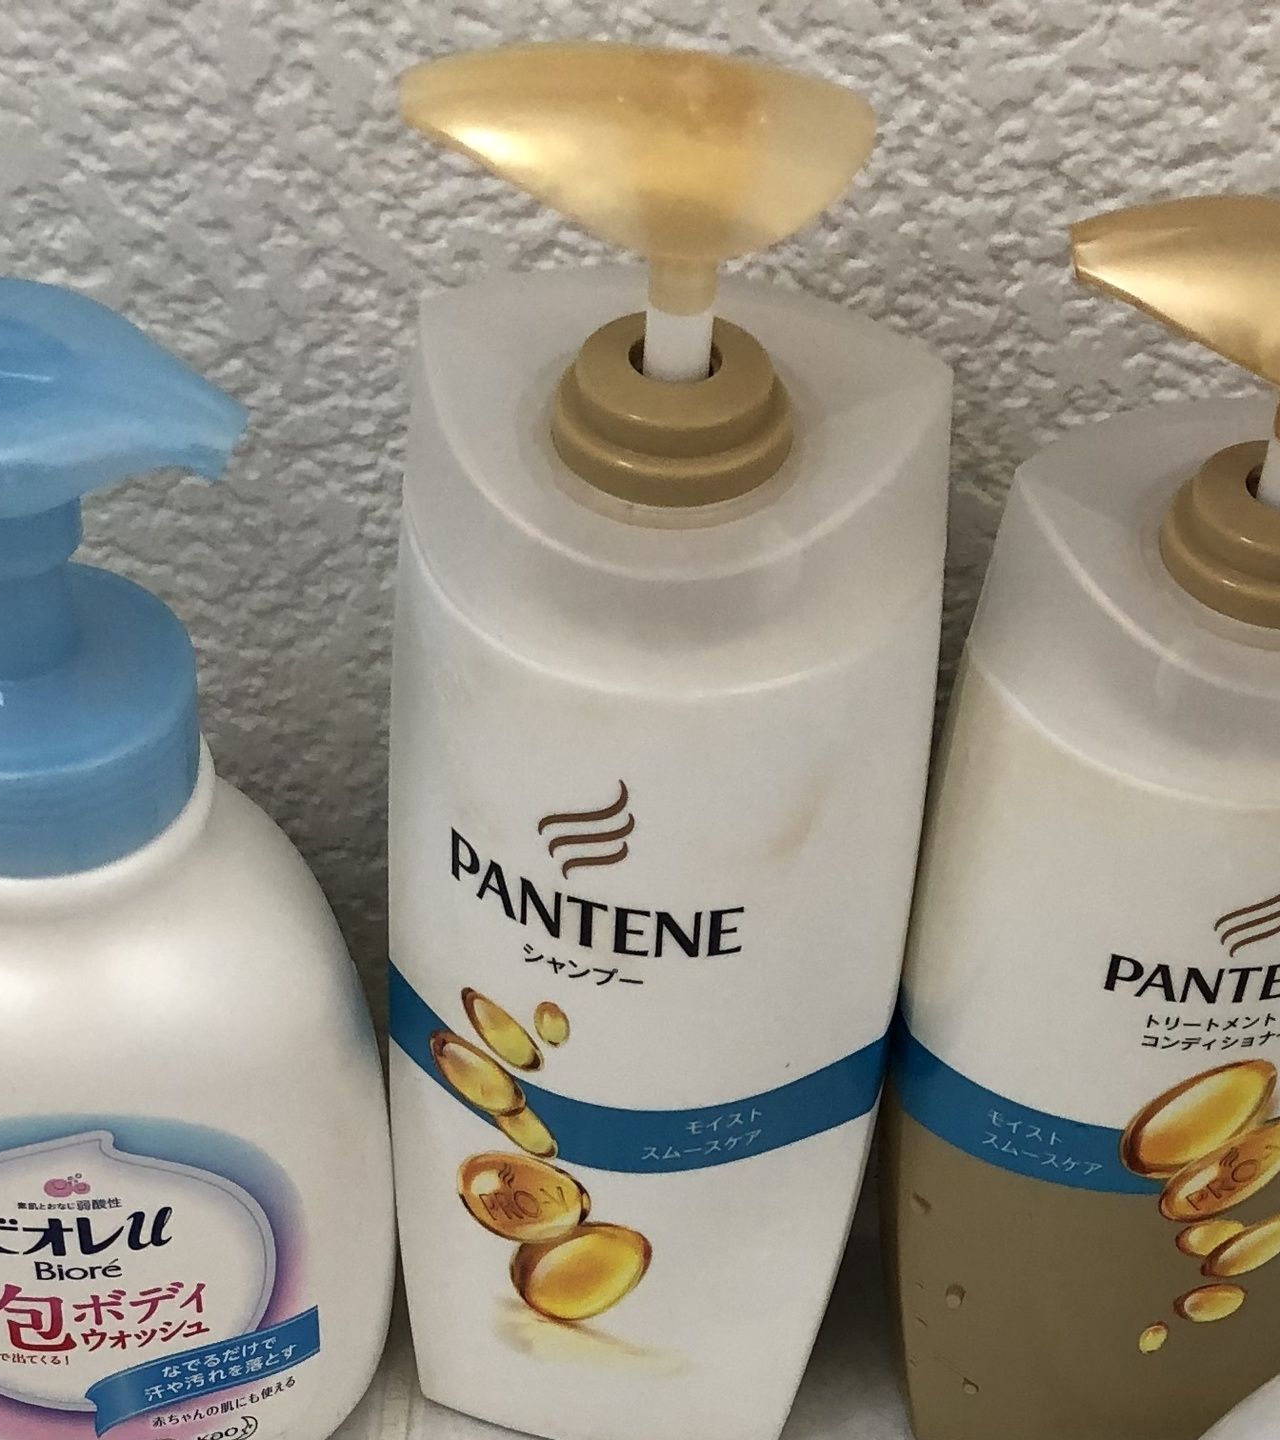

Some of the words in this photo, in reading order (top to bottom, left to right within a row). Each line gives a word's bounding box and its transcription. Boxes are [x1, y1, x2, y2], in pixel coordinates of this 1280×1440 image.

[450, 827, 745, 958] PANTENE
[523, 943, 644, 985] シャンプー
[1146, 1012, 1276, 1032] トリートメント
[686, 1108, 762, 1135] モイスト
[987, 1109, 1063, 1146] モイスト
[641, 1129, 762, 1159] スムースケア
[982, 1131, 1103, 1176] スムースケア
[33, 1258, 123, 1281] Bioré
[72, 1281, 207, 1326] ボディ
[80, 1320, 211, 1352] ウォッシュ
[161, 1336, 278, 1378] なでるだけで
[144, 1343, 298, 1402] 汗や汚れを落とす
[152, 1376, 297, 1428] 赤ちゃんの肌にも使える
